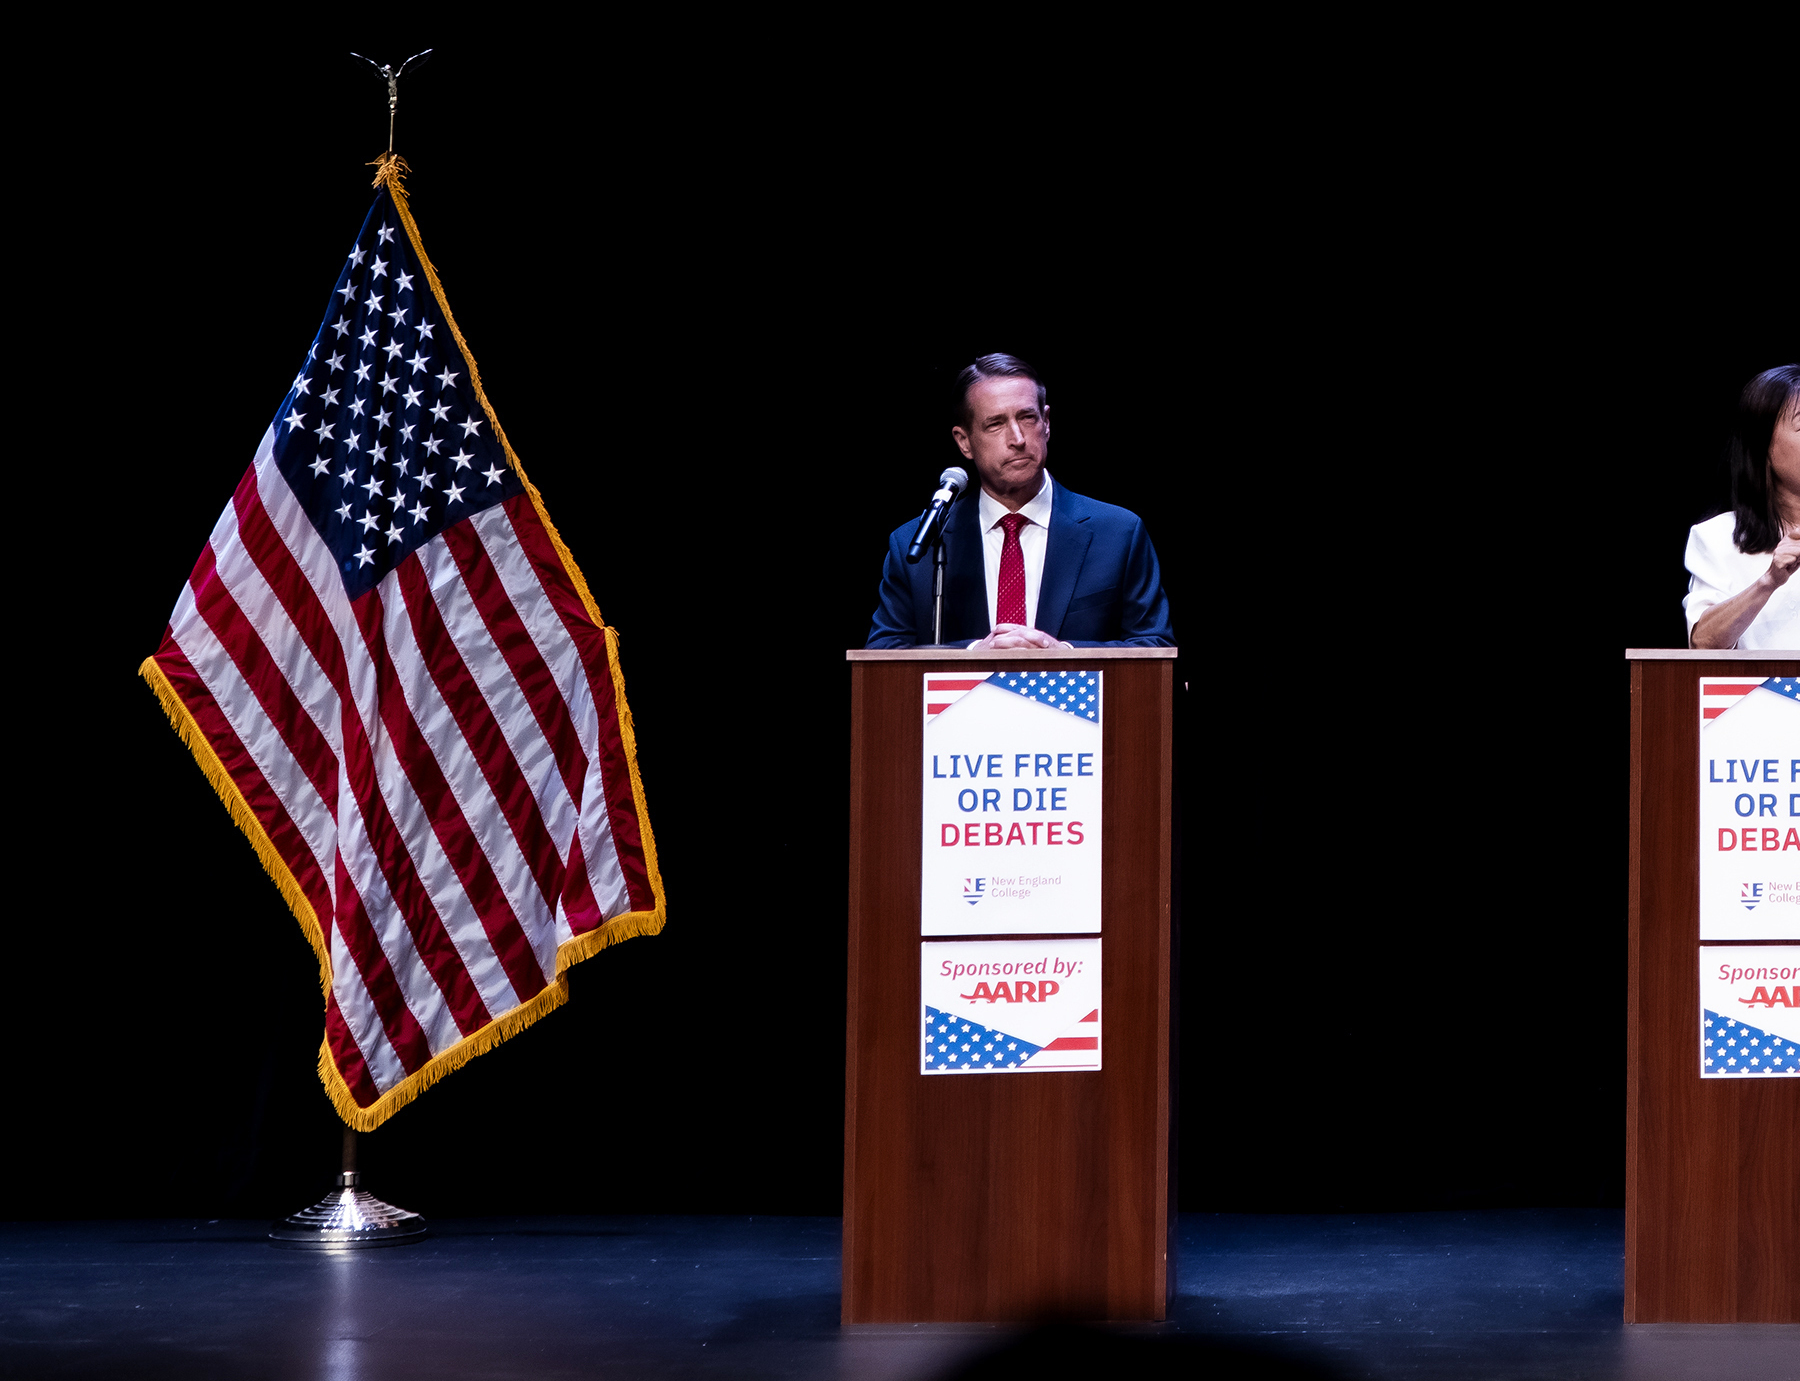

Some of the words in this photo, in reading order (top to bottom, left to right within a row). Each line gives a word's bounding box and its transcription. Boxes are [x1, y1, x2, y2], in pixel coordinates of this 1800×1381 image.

[933, 754, 1003, 779] LIVE
[1014, 752, 1094, 778] FREE
[1709, 759, 1779, 783] LIVE
[958, 788, 1001, 813] OR
[1013, 787, 1067, 812] DIE
[1734, 793, 1777, 818] OR
[941, 821, 1085, 847] DEBATES
[991, 876, 1016, 886] New
[1018, 875, 1062, 888] England
[991, 887, 1031, 899] College
[1768, 881, 1793, 891] New
[940, 957, 1047, 981] Sponsored
[1053, 957, 1083, 978] by:
[960, 980, 1060, 1004] AARP
